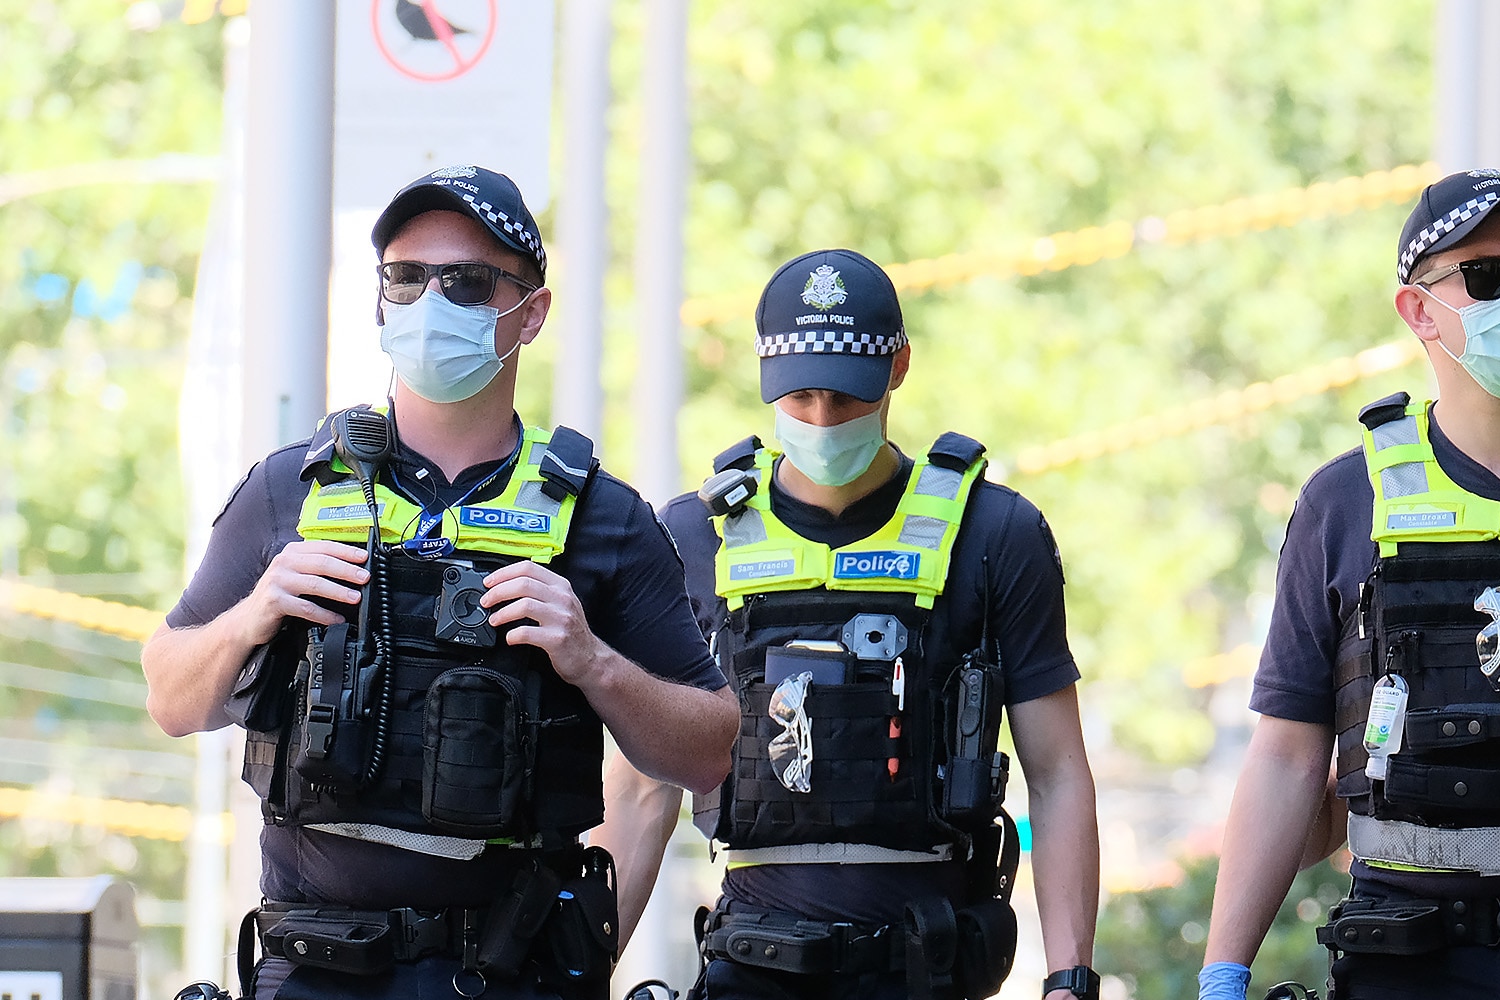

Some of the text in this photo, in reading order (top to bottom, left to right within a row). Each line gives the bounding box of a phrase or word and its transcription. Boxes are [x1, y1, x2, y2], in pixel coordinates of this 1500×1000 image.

[453, 180, 480, 194] POLICE
[795, 314, 855, 326] VICTORIA POLICE
[469, 509, 541, 528] Police
[737, 561, 788, 573] Sam Francis
[842, 555, 910, 574] Police
